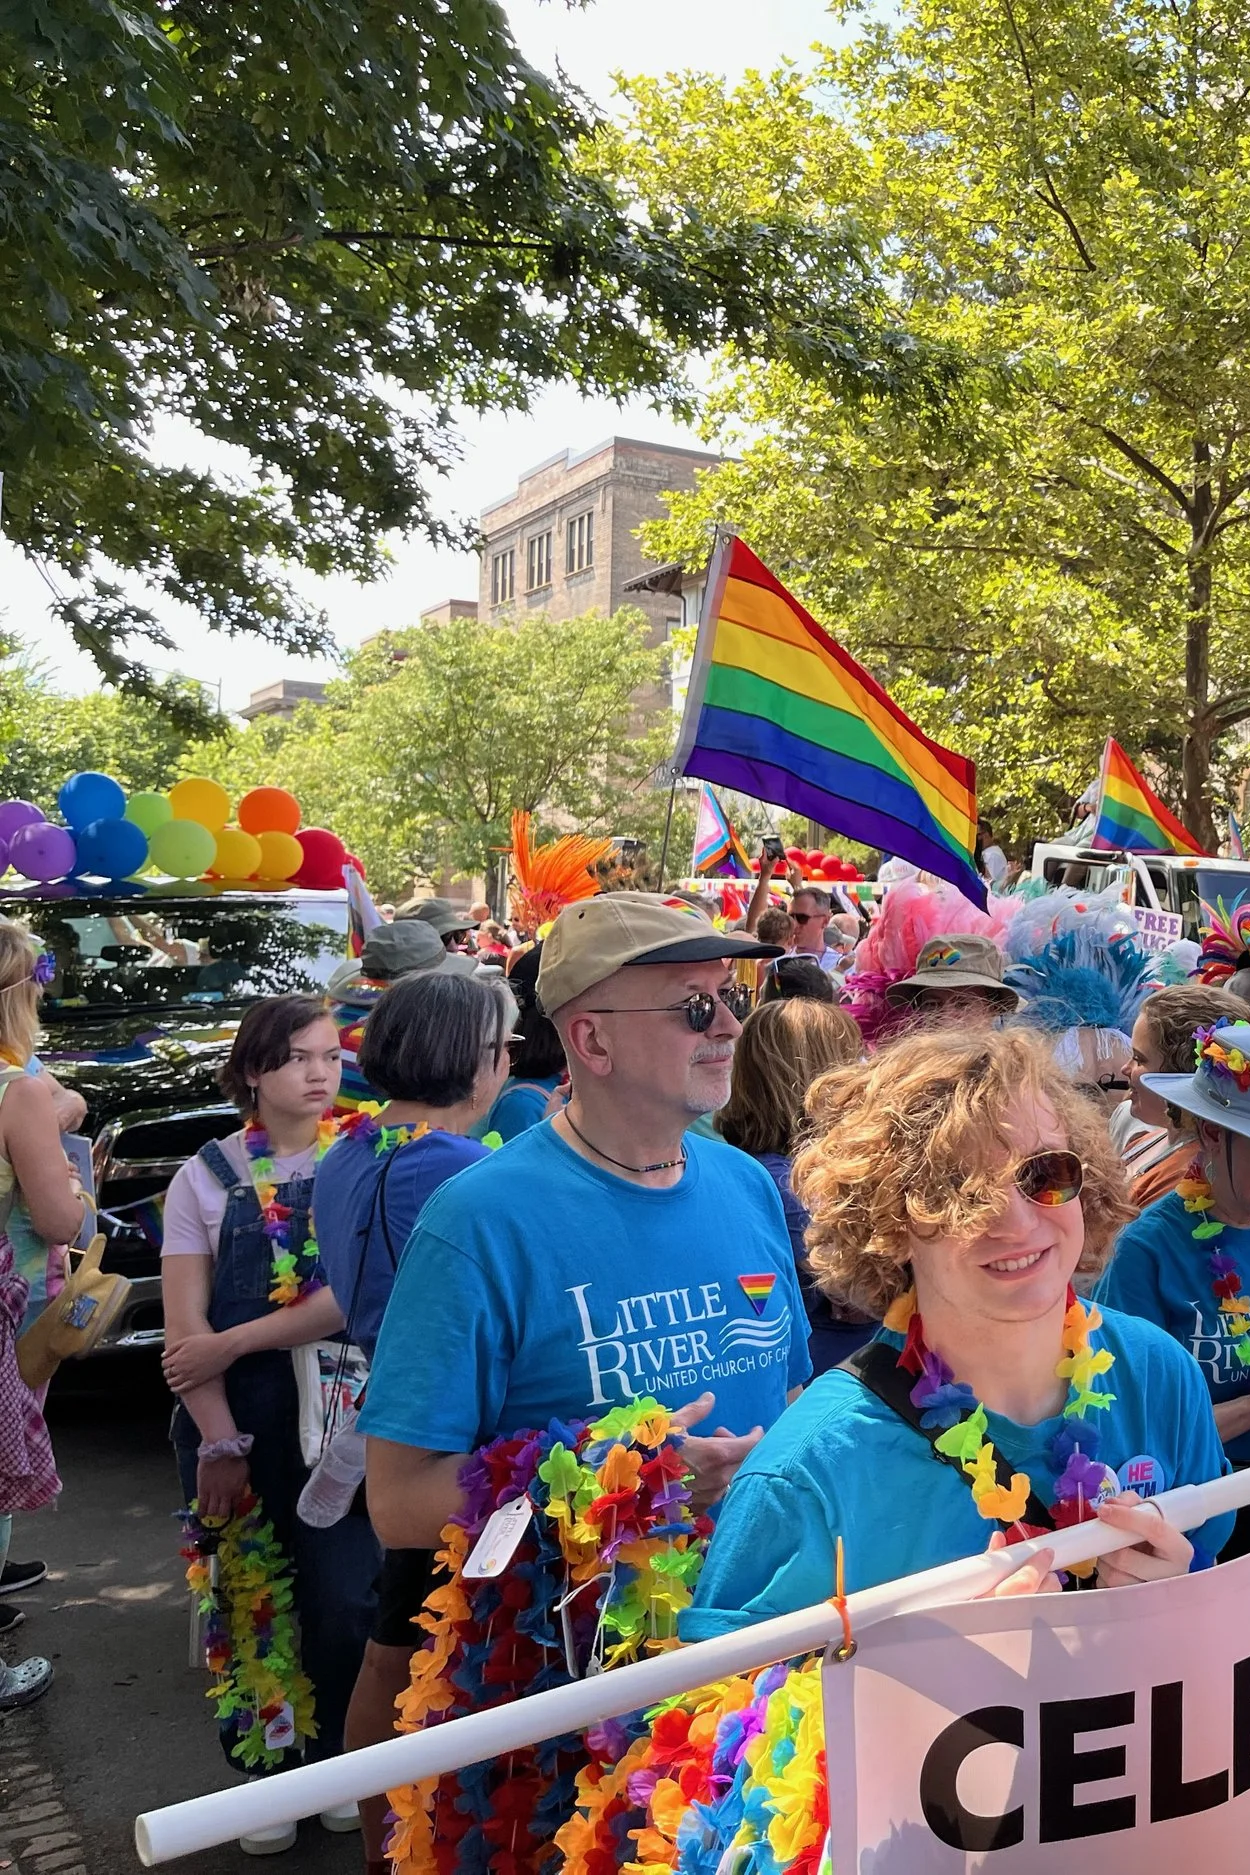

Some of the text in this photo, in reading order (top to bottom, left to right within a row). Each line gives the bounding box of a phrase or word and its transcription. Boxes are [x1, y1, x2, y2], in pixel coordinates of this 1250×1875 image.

[565, 1282, 727, 1346] LITTLE
[578, 1329, 716, 1406] RIVER
[645, 1368, 698, 1393] UNITED
[702, 1355, 756, 1381] CHURCH
[759, 1350, 774, 1368] OF
[1128, 1461, 1153, 1483] HE
